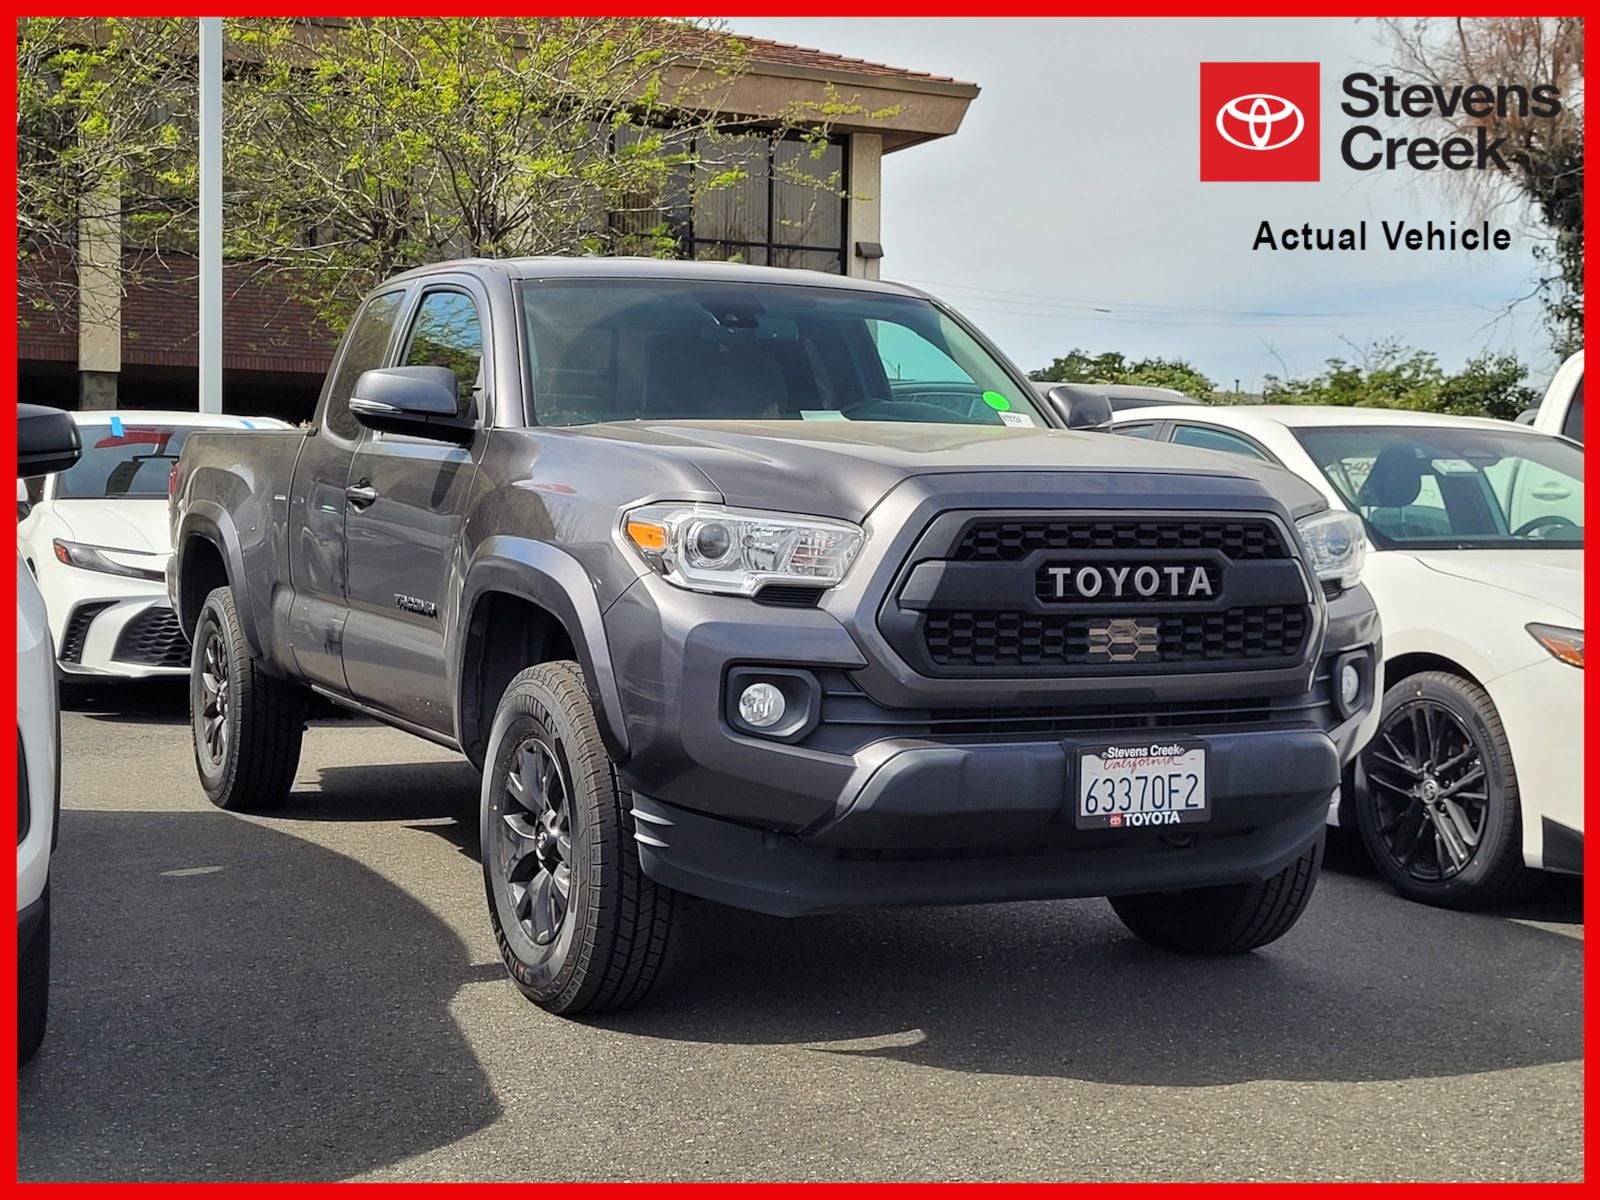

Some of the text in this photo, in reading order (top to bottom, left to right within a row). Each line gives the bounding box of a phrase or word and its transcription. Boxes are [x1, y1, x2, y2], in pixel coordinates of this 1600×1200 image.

[1049, 565, 1213, 598] TOYOTA
[1107, 743, 1181, 758] Stevens Creek
[1104, 756, 1184, 774] California
[1085, 773, 1199, 814] 63370F2
[1123, 810, 1181, 828] TOYOTA
